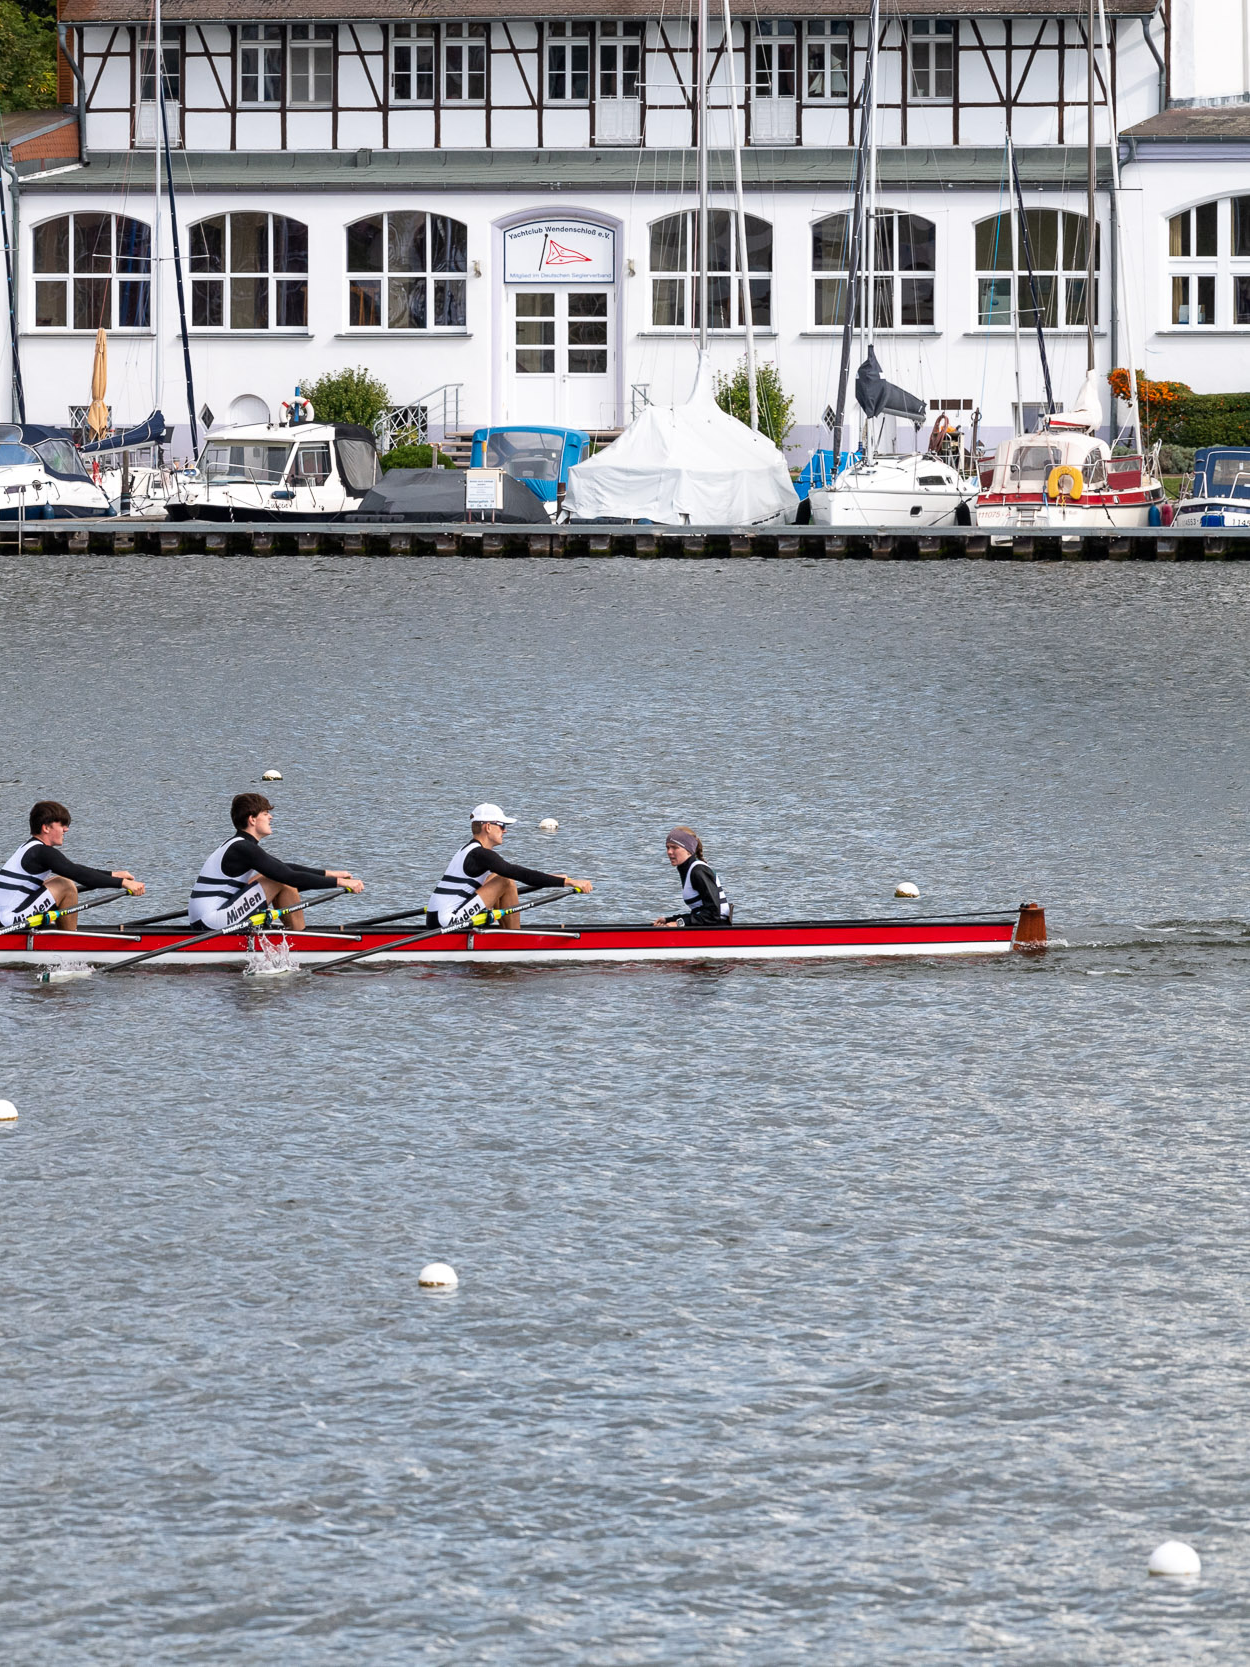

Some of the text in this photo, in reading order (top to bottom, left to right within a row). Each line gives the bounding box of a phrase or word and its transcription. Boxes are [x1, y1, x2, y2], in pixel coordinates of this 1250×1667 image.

[508, 226, 610, 240] Yachtclub Wendenschloß e.V.
[227, 892, 262, 925] Minden
